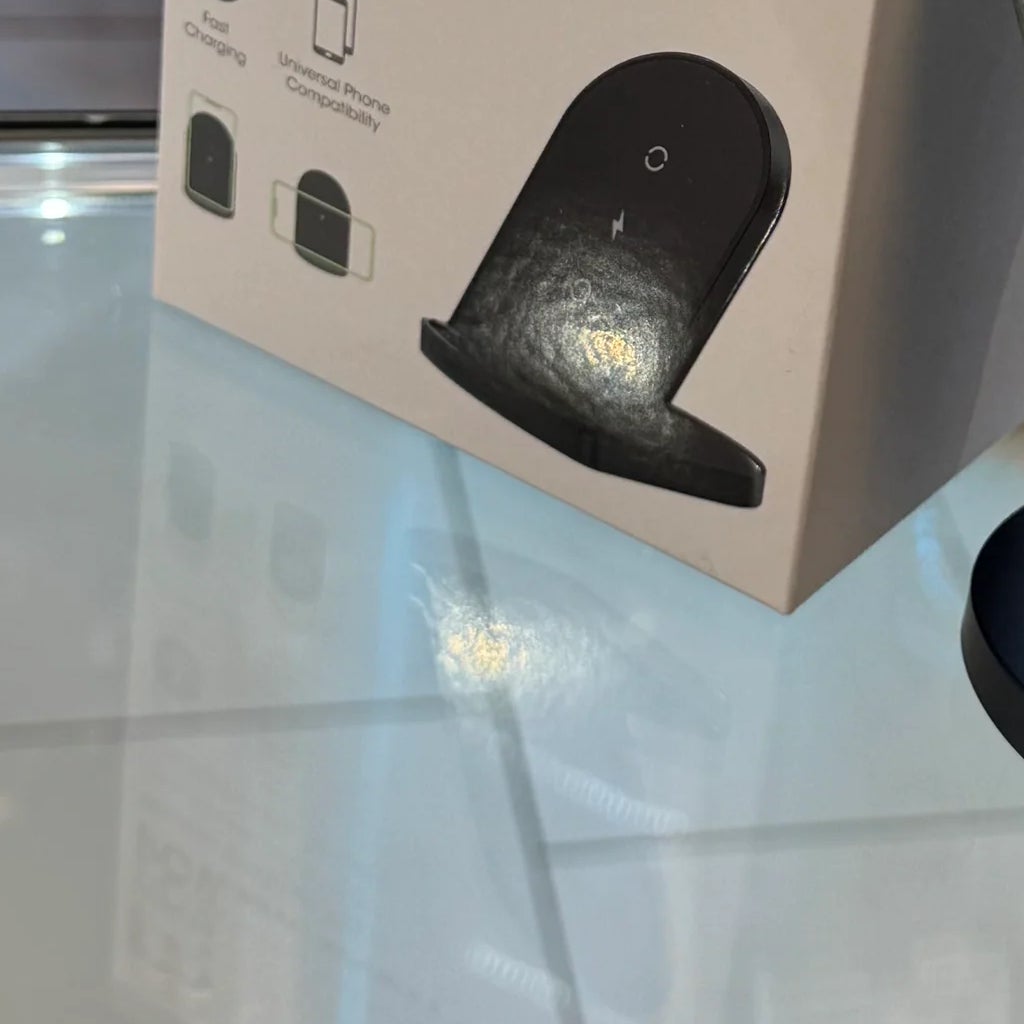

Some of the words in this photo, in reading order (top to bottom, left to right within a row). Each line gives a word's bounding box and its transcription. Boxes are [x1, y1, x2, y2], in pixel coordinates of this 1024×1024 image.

[184, 21, 247, 67] Charging
[203, 10, 230, 35] Fast
[278, 51, 340, 93] Universal
[344, 84, 391, 115] Phone
[286, 76, 381, 133] Compatibility
